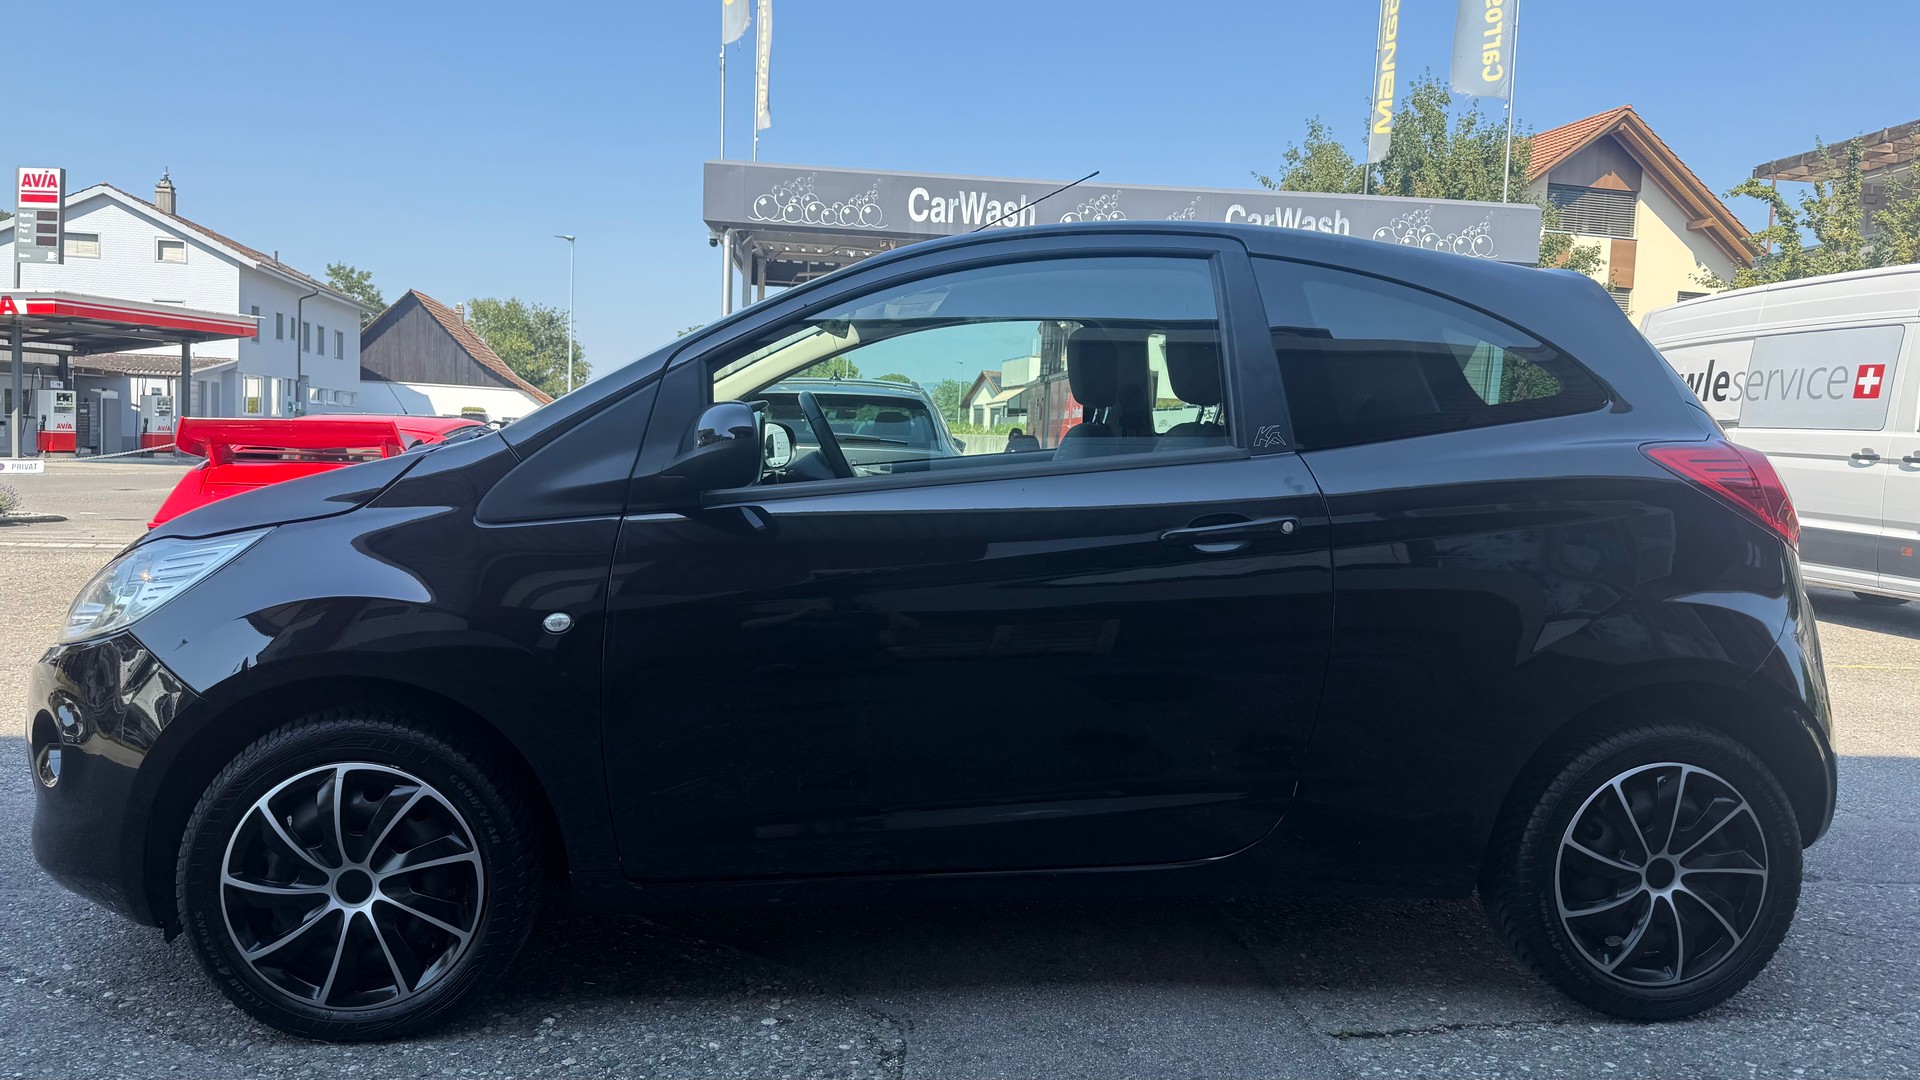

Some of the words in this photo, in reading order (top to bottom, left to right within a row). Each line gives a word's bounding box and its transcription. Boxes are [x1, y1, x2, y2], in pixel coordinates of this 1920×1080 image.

[21, 170, 58, 188] AVIA
[908, 187, 1036, 228] CarWash
[1224, 203, 1350, 236] CarWash
[56, 422, 73, 430] AVIA
[11, 463, 38, 471] PRIVAT
[449, 774, 502, 844] GOODYEAR
